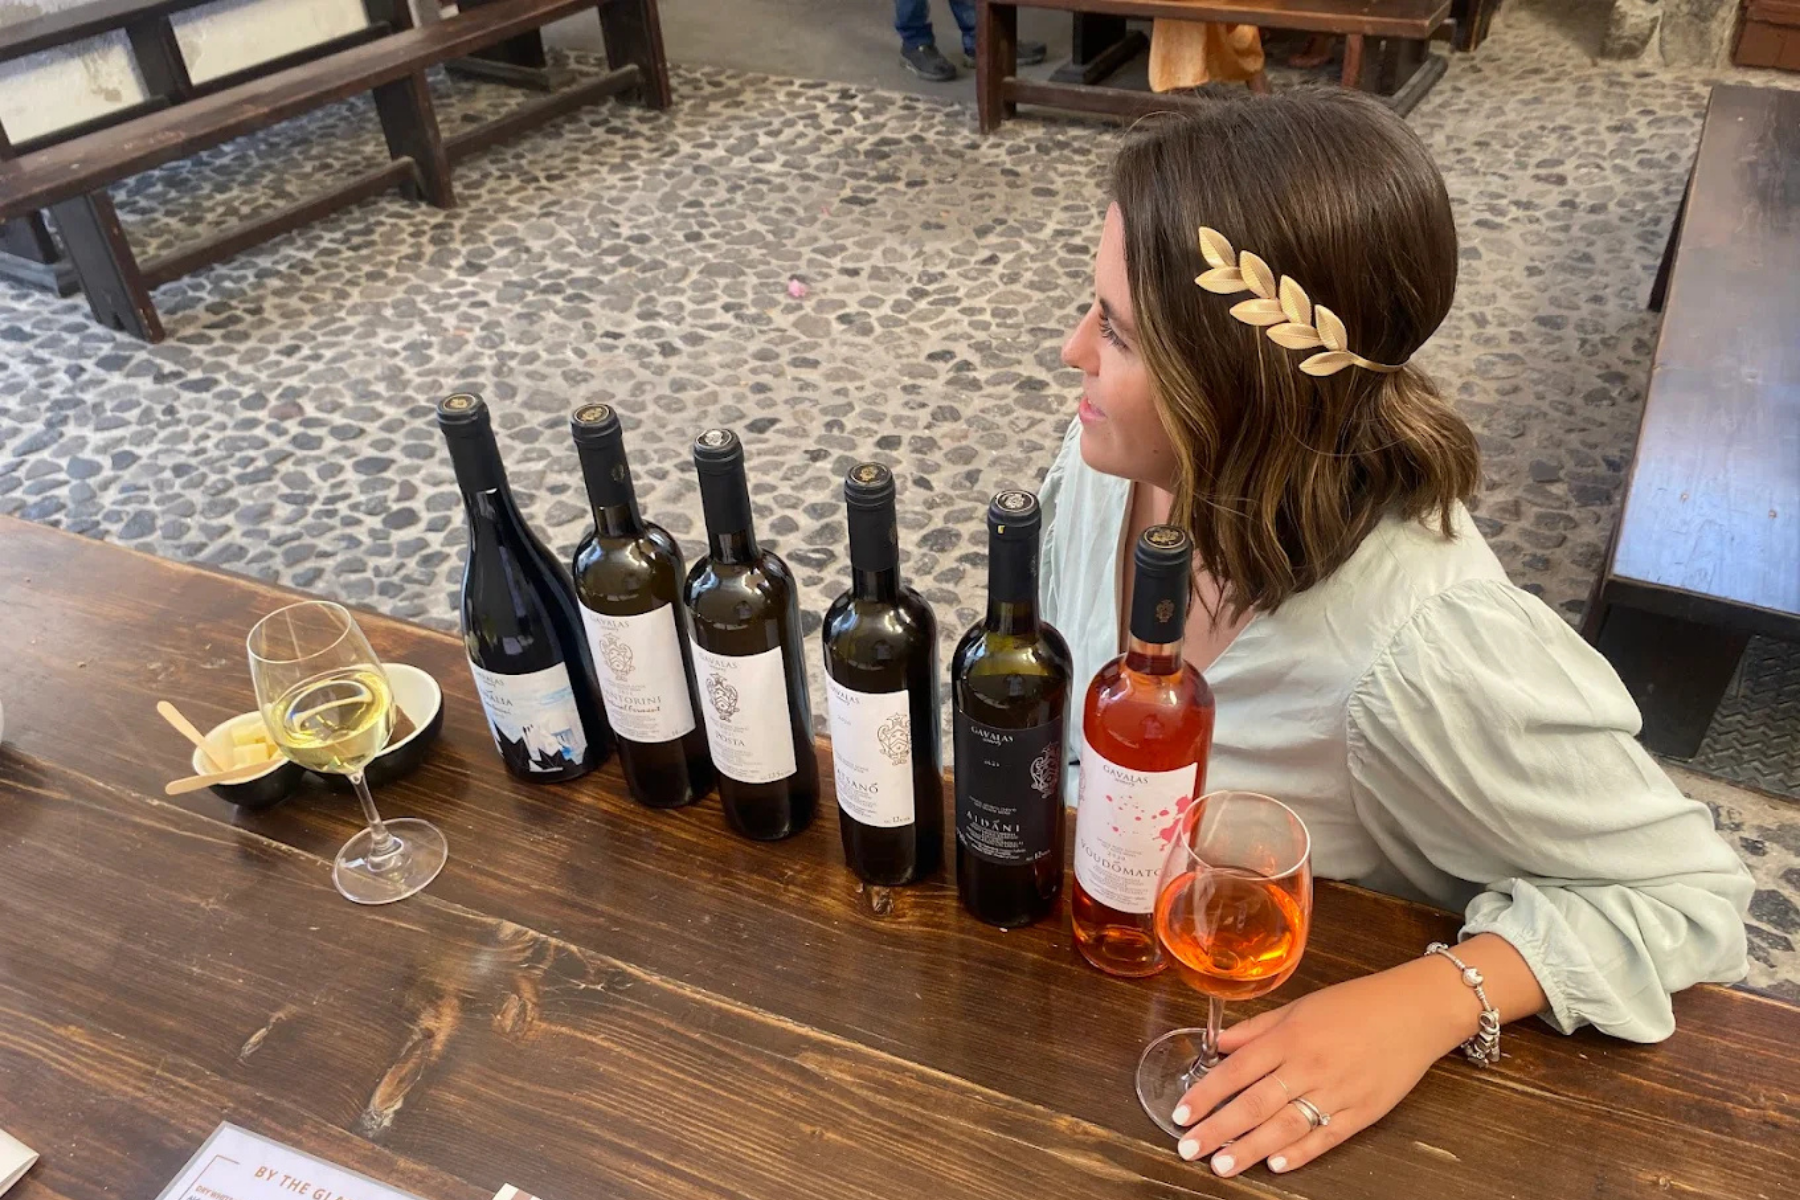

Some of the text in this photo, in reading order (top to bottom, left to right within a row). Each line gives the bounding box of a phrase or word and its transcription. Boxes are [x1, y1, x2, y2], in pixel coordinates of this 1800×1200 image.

[970, 726, 1014, 743] GAVALAS
[1103, 764, 1149, 785] GAVALAS
[254, 1166, 279, 1182] BY
[279, 1174, 311, 1195] THE
